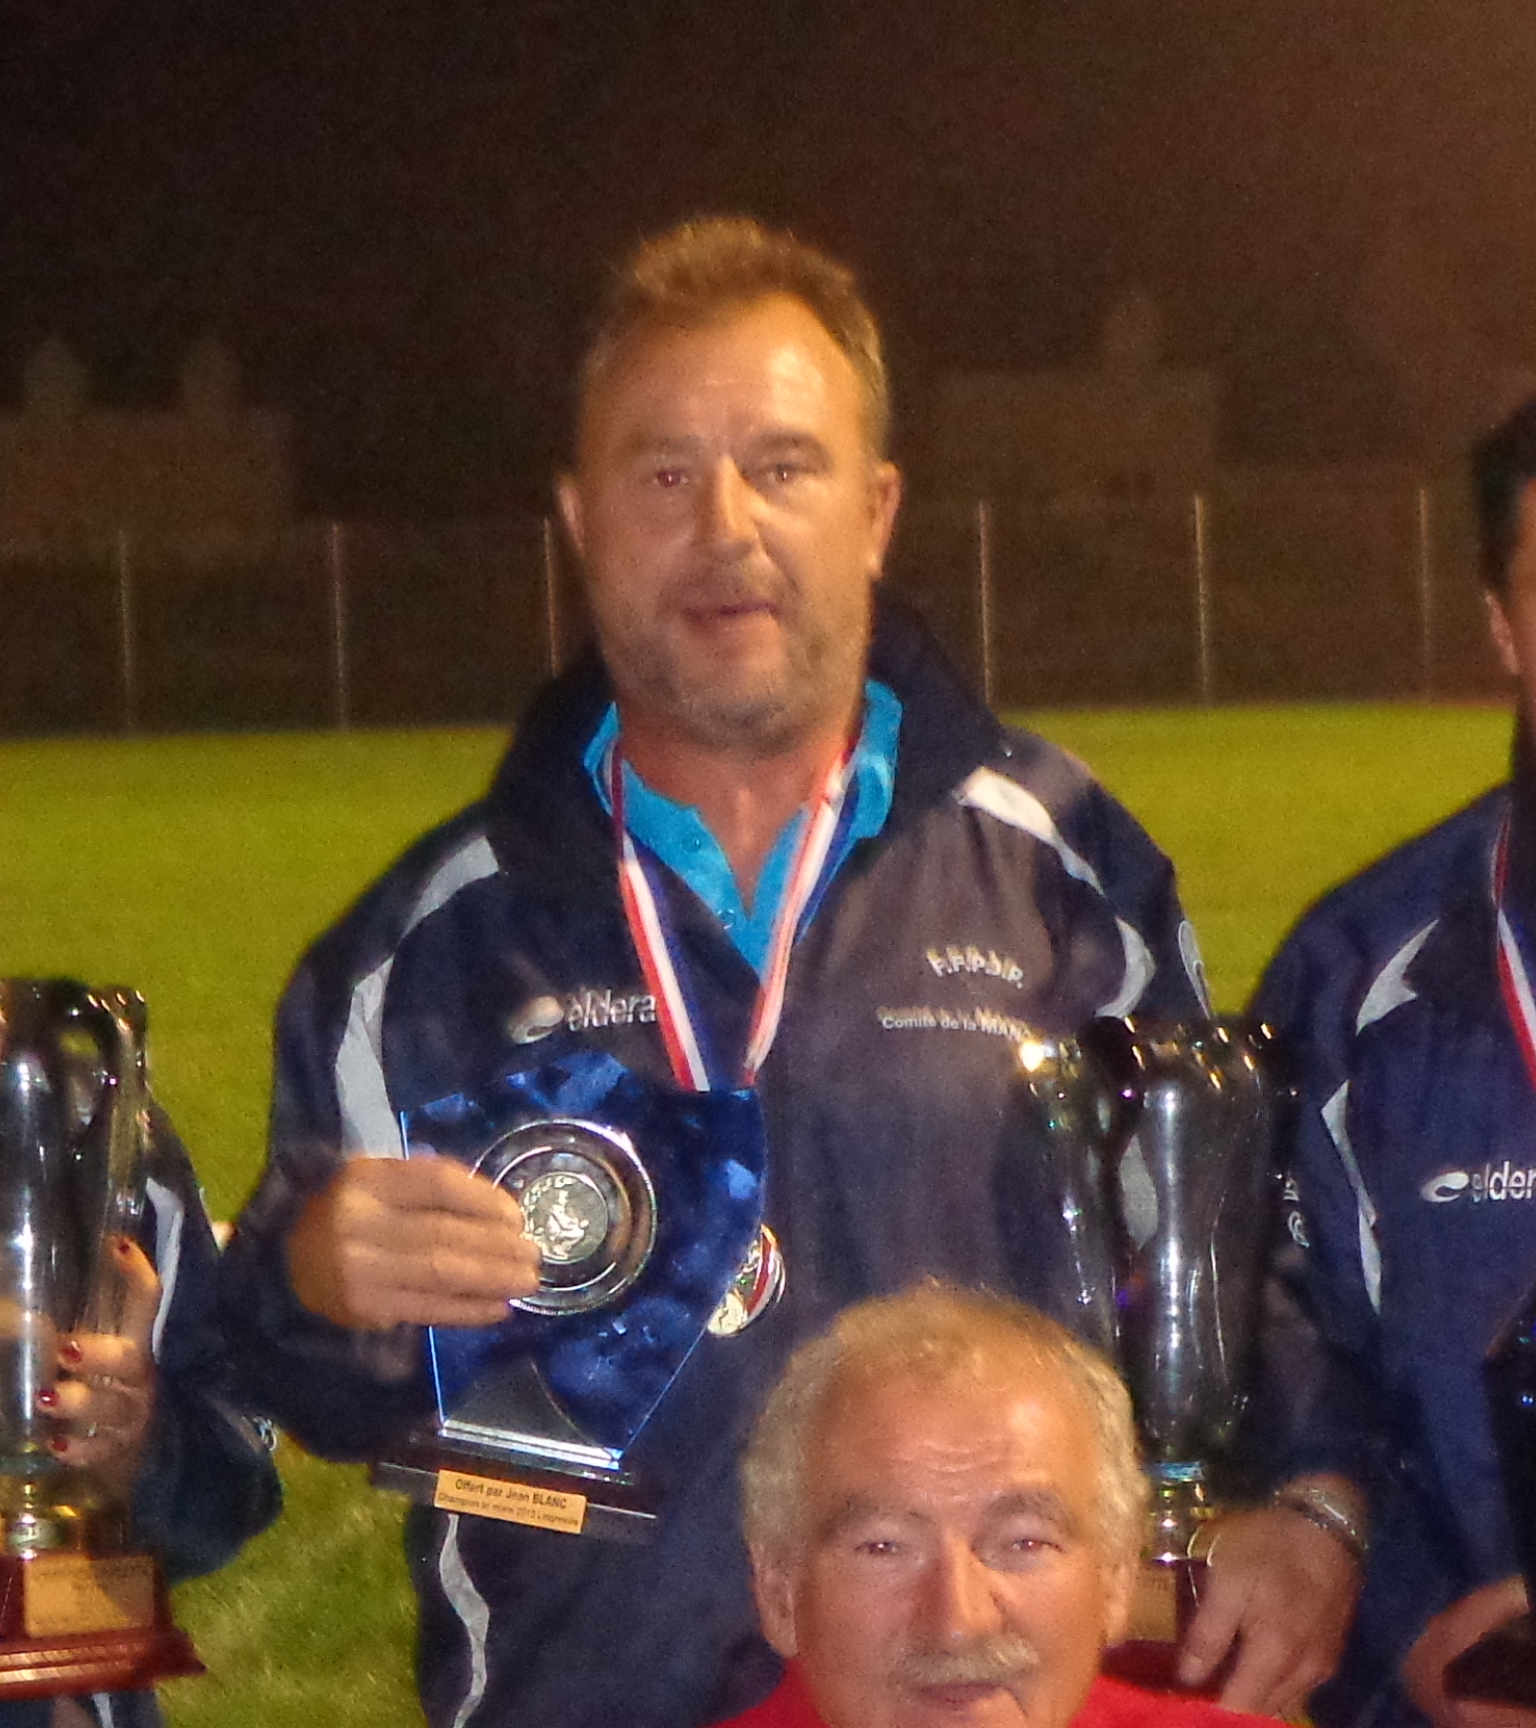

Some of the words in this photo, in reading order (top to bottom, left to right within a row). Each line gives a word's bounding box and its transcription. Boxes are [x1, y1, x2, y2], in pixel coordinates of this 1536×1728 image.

[567, 987, 657, 1031] eldera
[939, 1011, 959, 1030] de
[962, 1012, 977, 1031] la
[455, 1478, 484, 1494] Offert
[486, 1486, 504, 1498] par
[532, 1493, 568, 1509] BLANC
